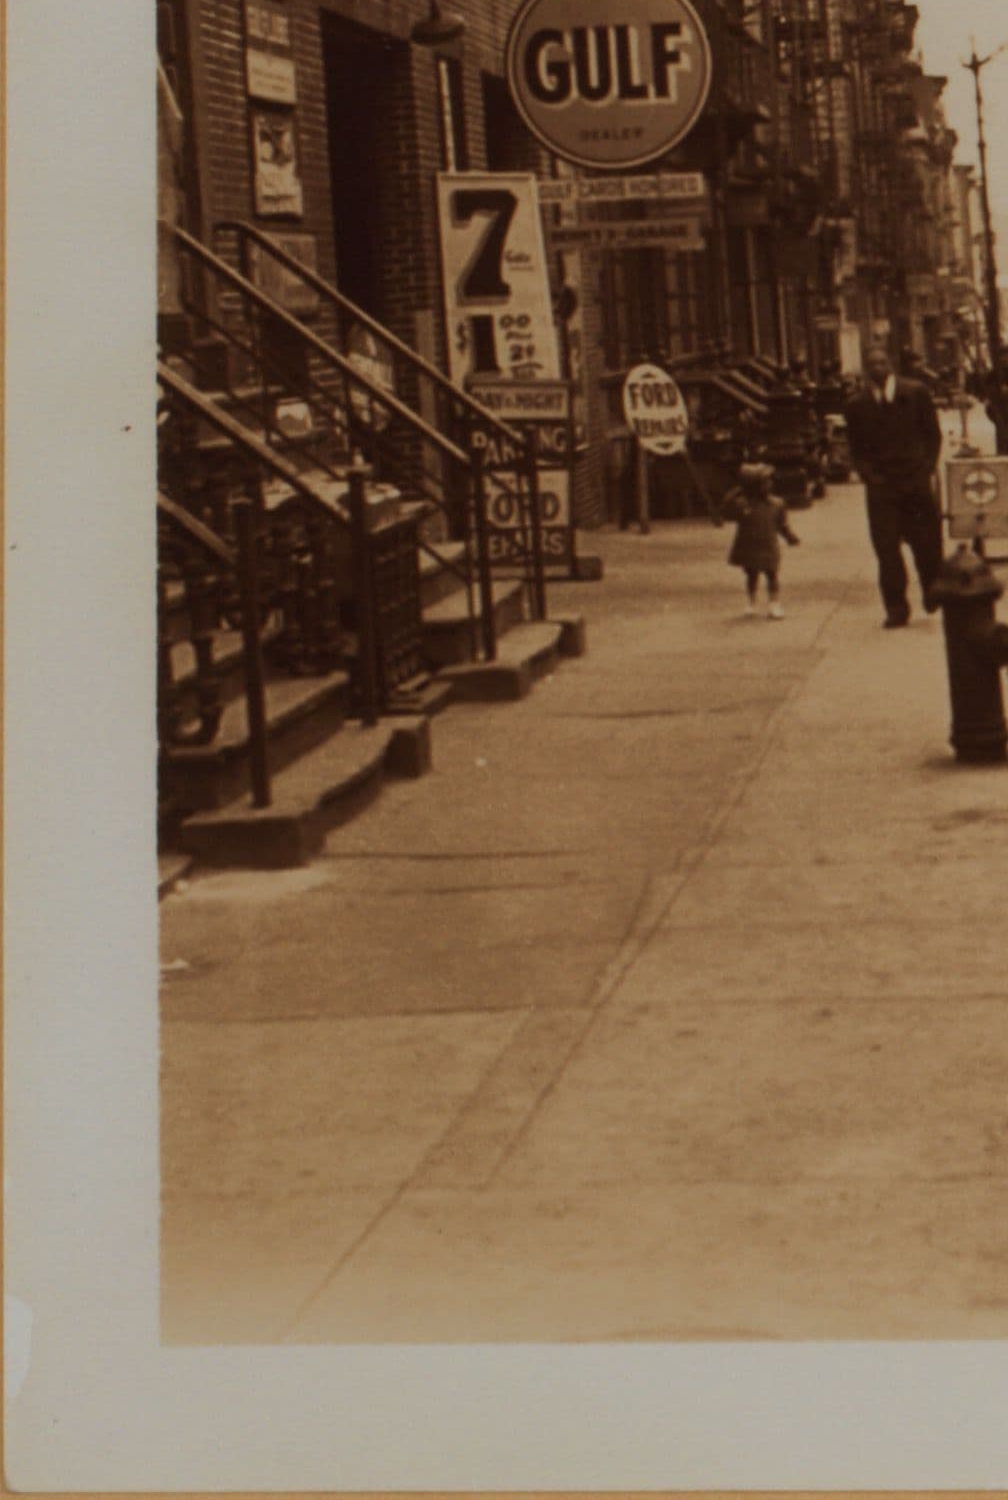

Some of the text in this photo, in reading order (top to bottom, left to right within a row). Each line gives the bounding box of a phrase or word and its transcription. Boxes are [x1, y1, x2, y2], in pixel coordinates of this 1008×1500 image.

[523, 22, 691, 108] GULF
[451, 188, 519, 307] 7
[628, 382, 678, 410] FORD
[632, 414, 688, 438] REPAIRS
